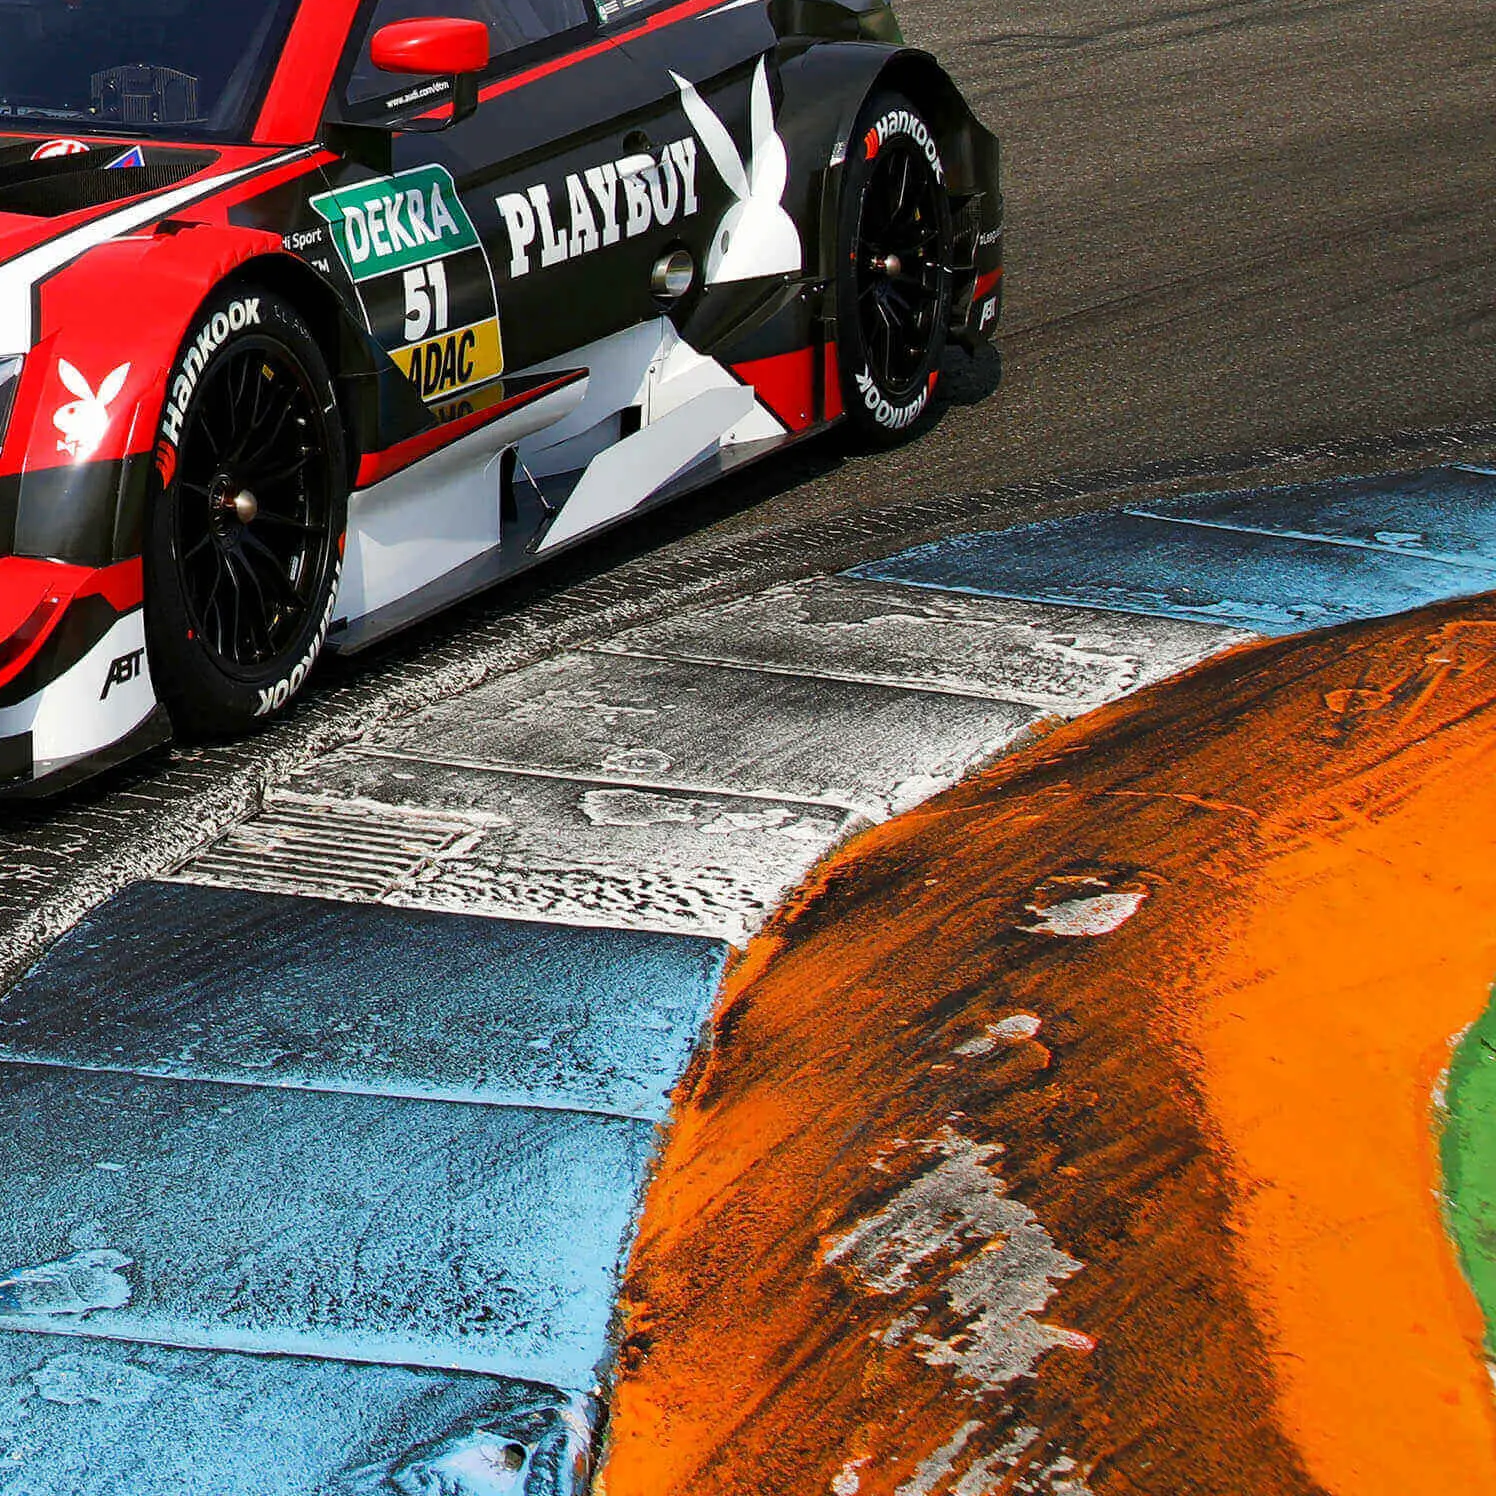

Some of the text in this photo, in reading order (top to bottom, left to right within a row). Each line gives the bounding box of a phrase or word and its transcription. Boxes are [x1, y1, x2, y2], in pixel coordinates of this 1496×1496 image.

[292, 227, 323, 250] Sport
[341, 183, 460, 264] DEKRA
[495, 136, 698, 279] PLAYBOY
[403, 260, 449, 342] 51
[408, 329, 476, 397] ADAC
[99, 646, 146, 702] ABT
